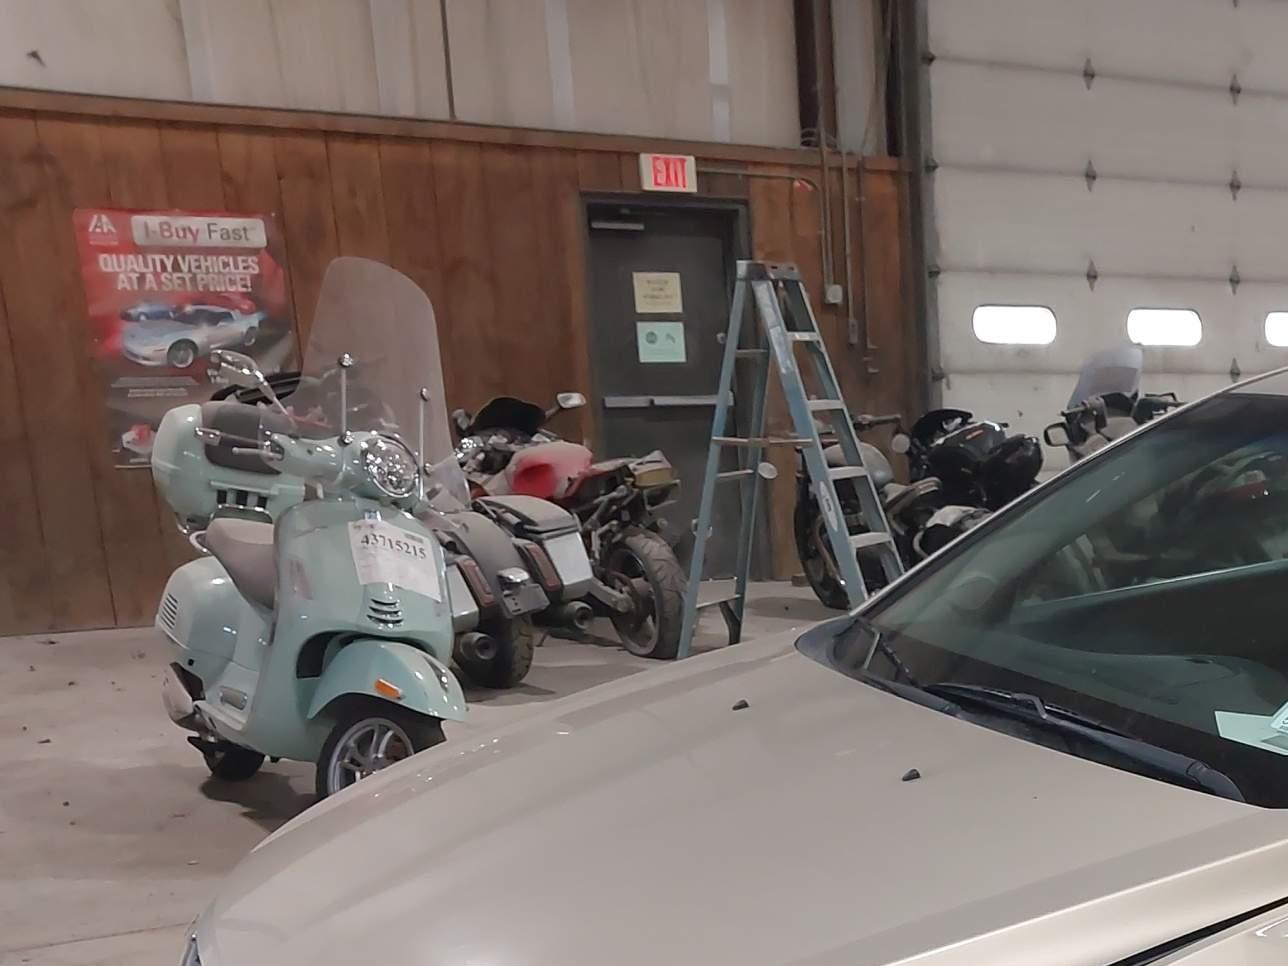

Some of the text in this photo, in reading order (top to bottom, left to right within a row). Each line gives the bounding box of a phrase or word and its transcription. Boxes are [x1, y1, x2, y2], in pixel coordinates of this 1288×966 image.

[652, 156, 686, 188] EXIT
[144, 221, 249, 244] I-Buy Fast
[100, 254, 259, 274] QUALITY VEHICLES
[117, 273, 253, 292] AT A SET PRICE!
[361, 533, 426, 559] 43715215
